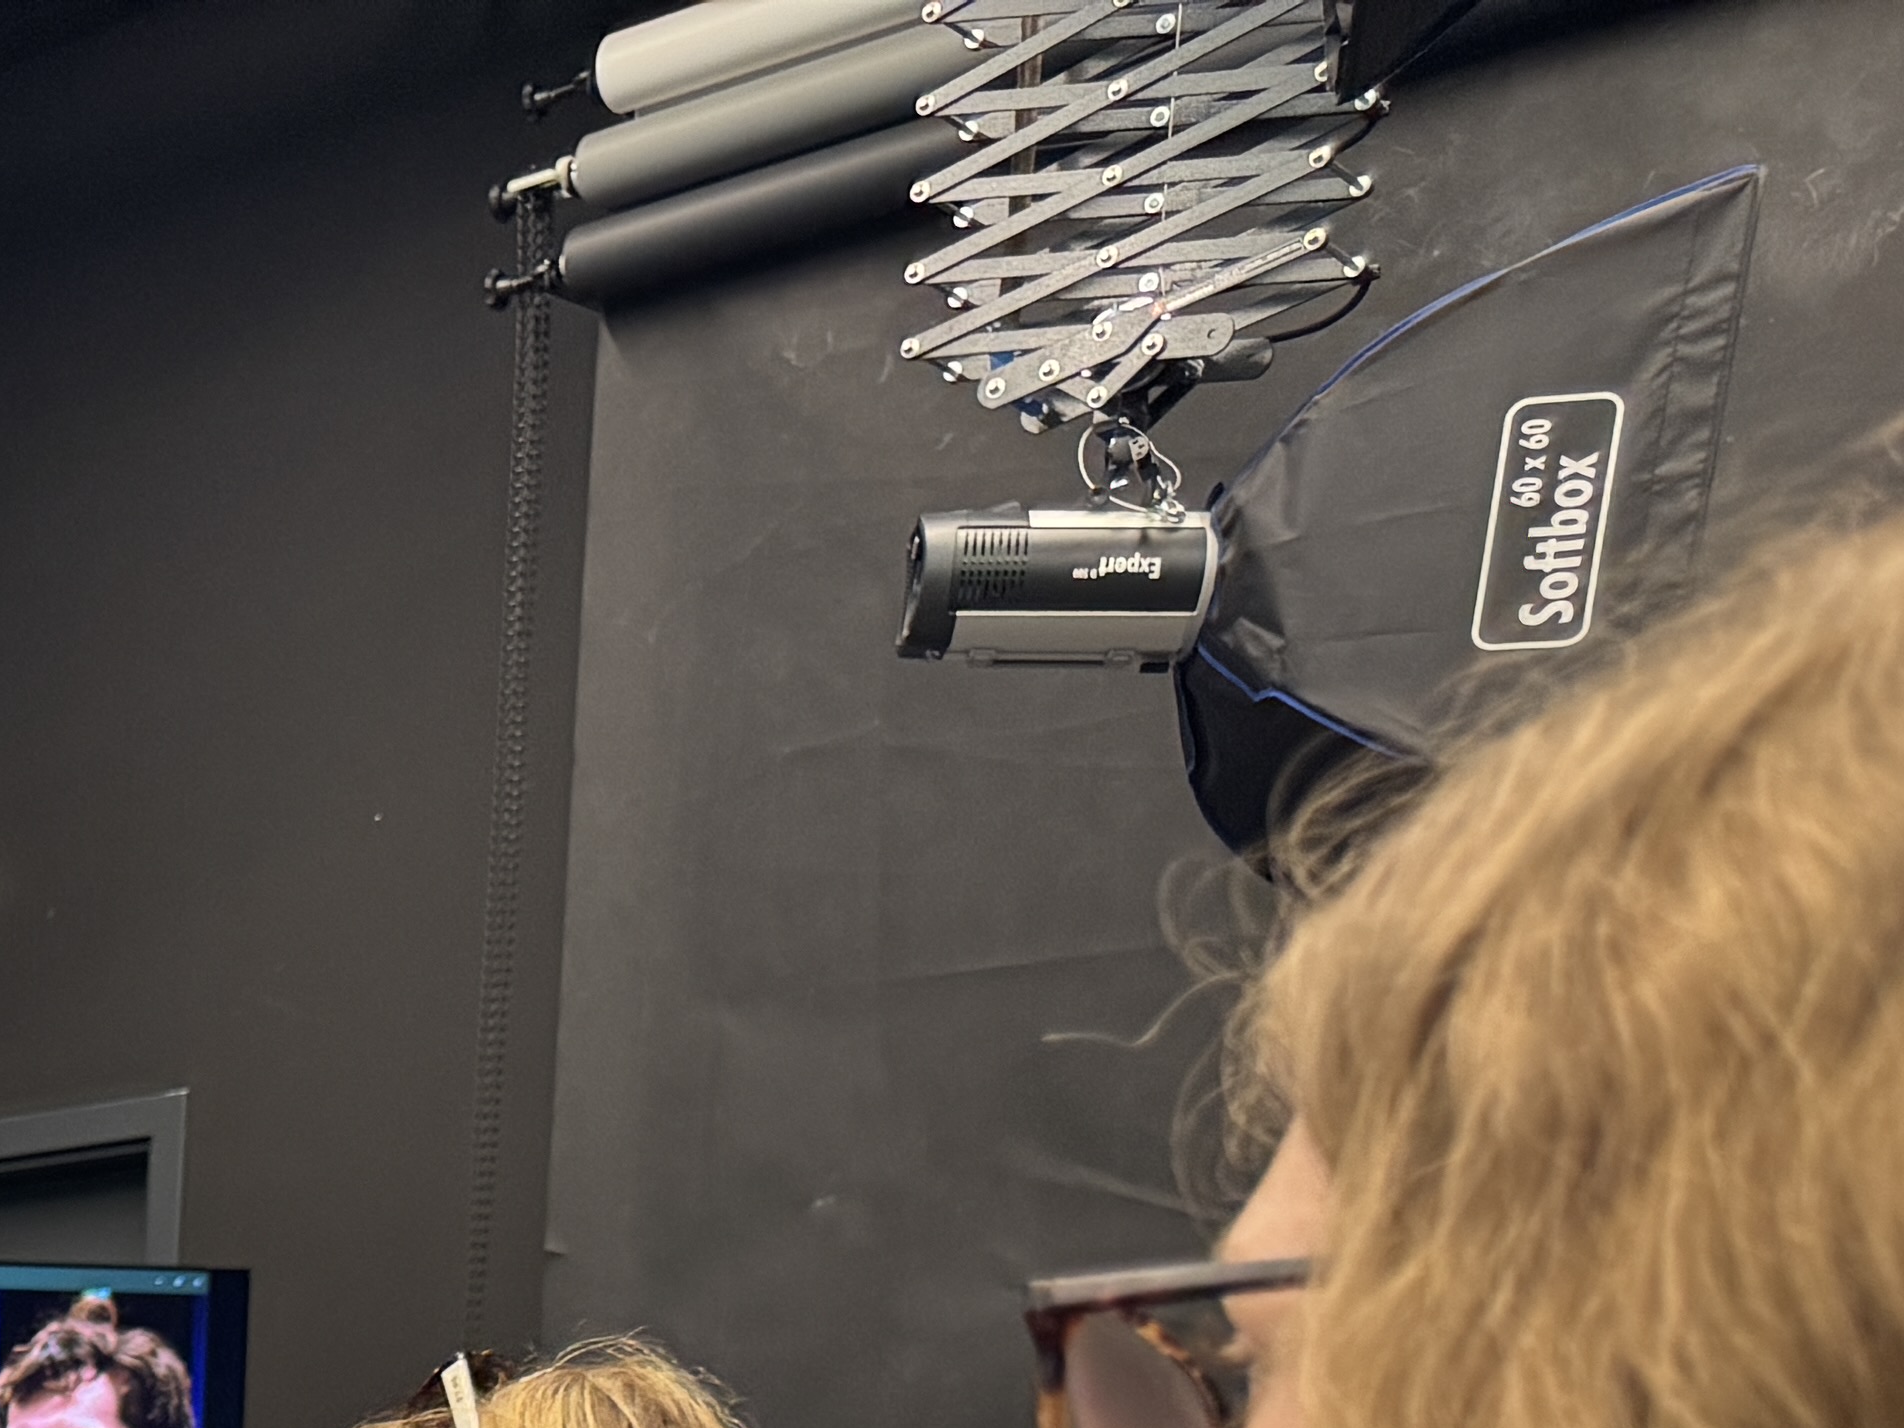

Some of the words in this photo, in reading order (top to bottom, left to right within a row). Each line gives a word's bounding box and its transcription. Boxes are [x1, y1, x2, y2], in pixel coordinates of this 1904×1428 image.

[1518, 418, 1552, 450] 60
[1509, 476, 1542, 509] 60
[1518, 451, 1600, 628] Softbox
[1098, 551, 1162, 580] Expert
